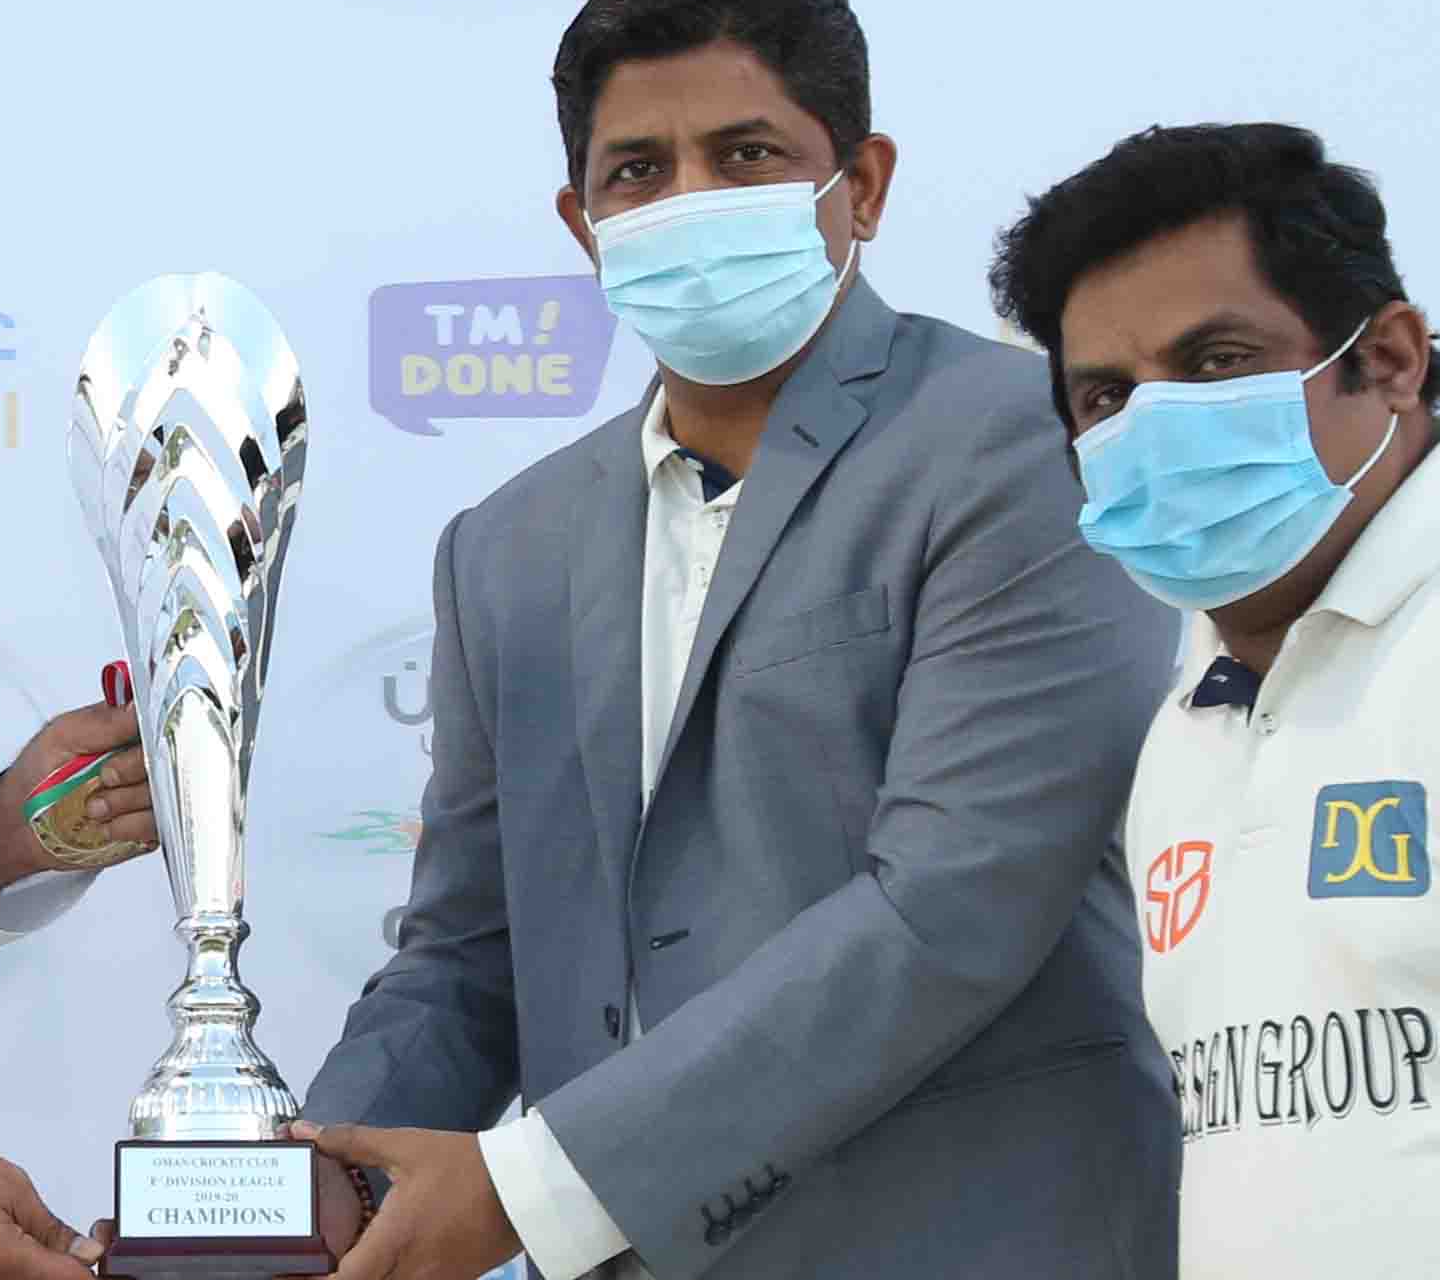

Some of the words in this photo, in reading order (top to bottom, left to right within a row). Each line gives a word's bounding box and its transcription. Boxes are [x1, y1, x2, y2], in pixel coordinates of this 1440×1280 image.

[401, 354, 574, 396] DONE
[1256, 1007, 1437, 1131] GROUP
[147, 1207, 287, 1224] CHAMPIONS
